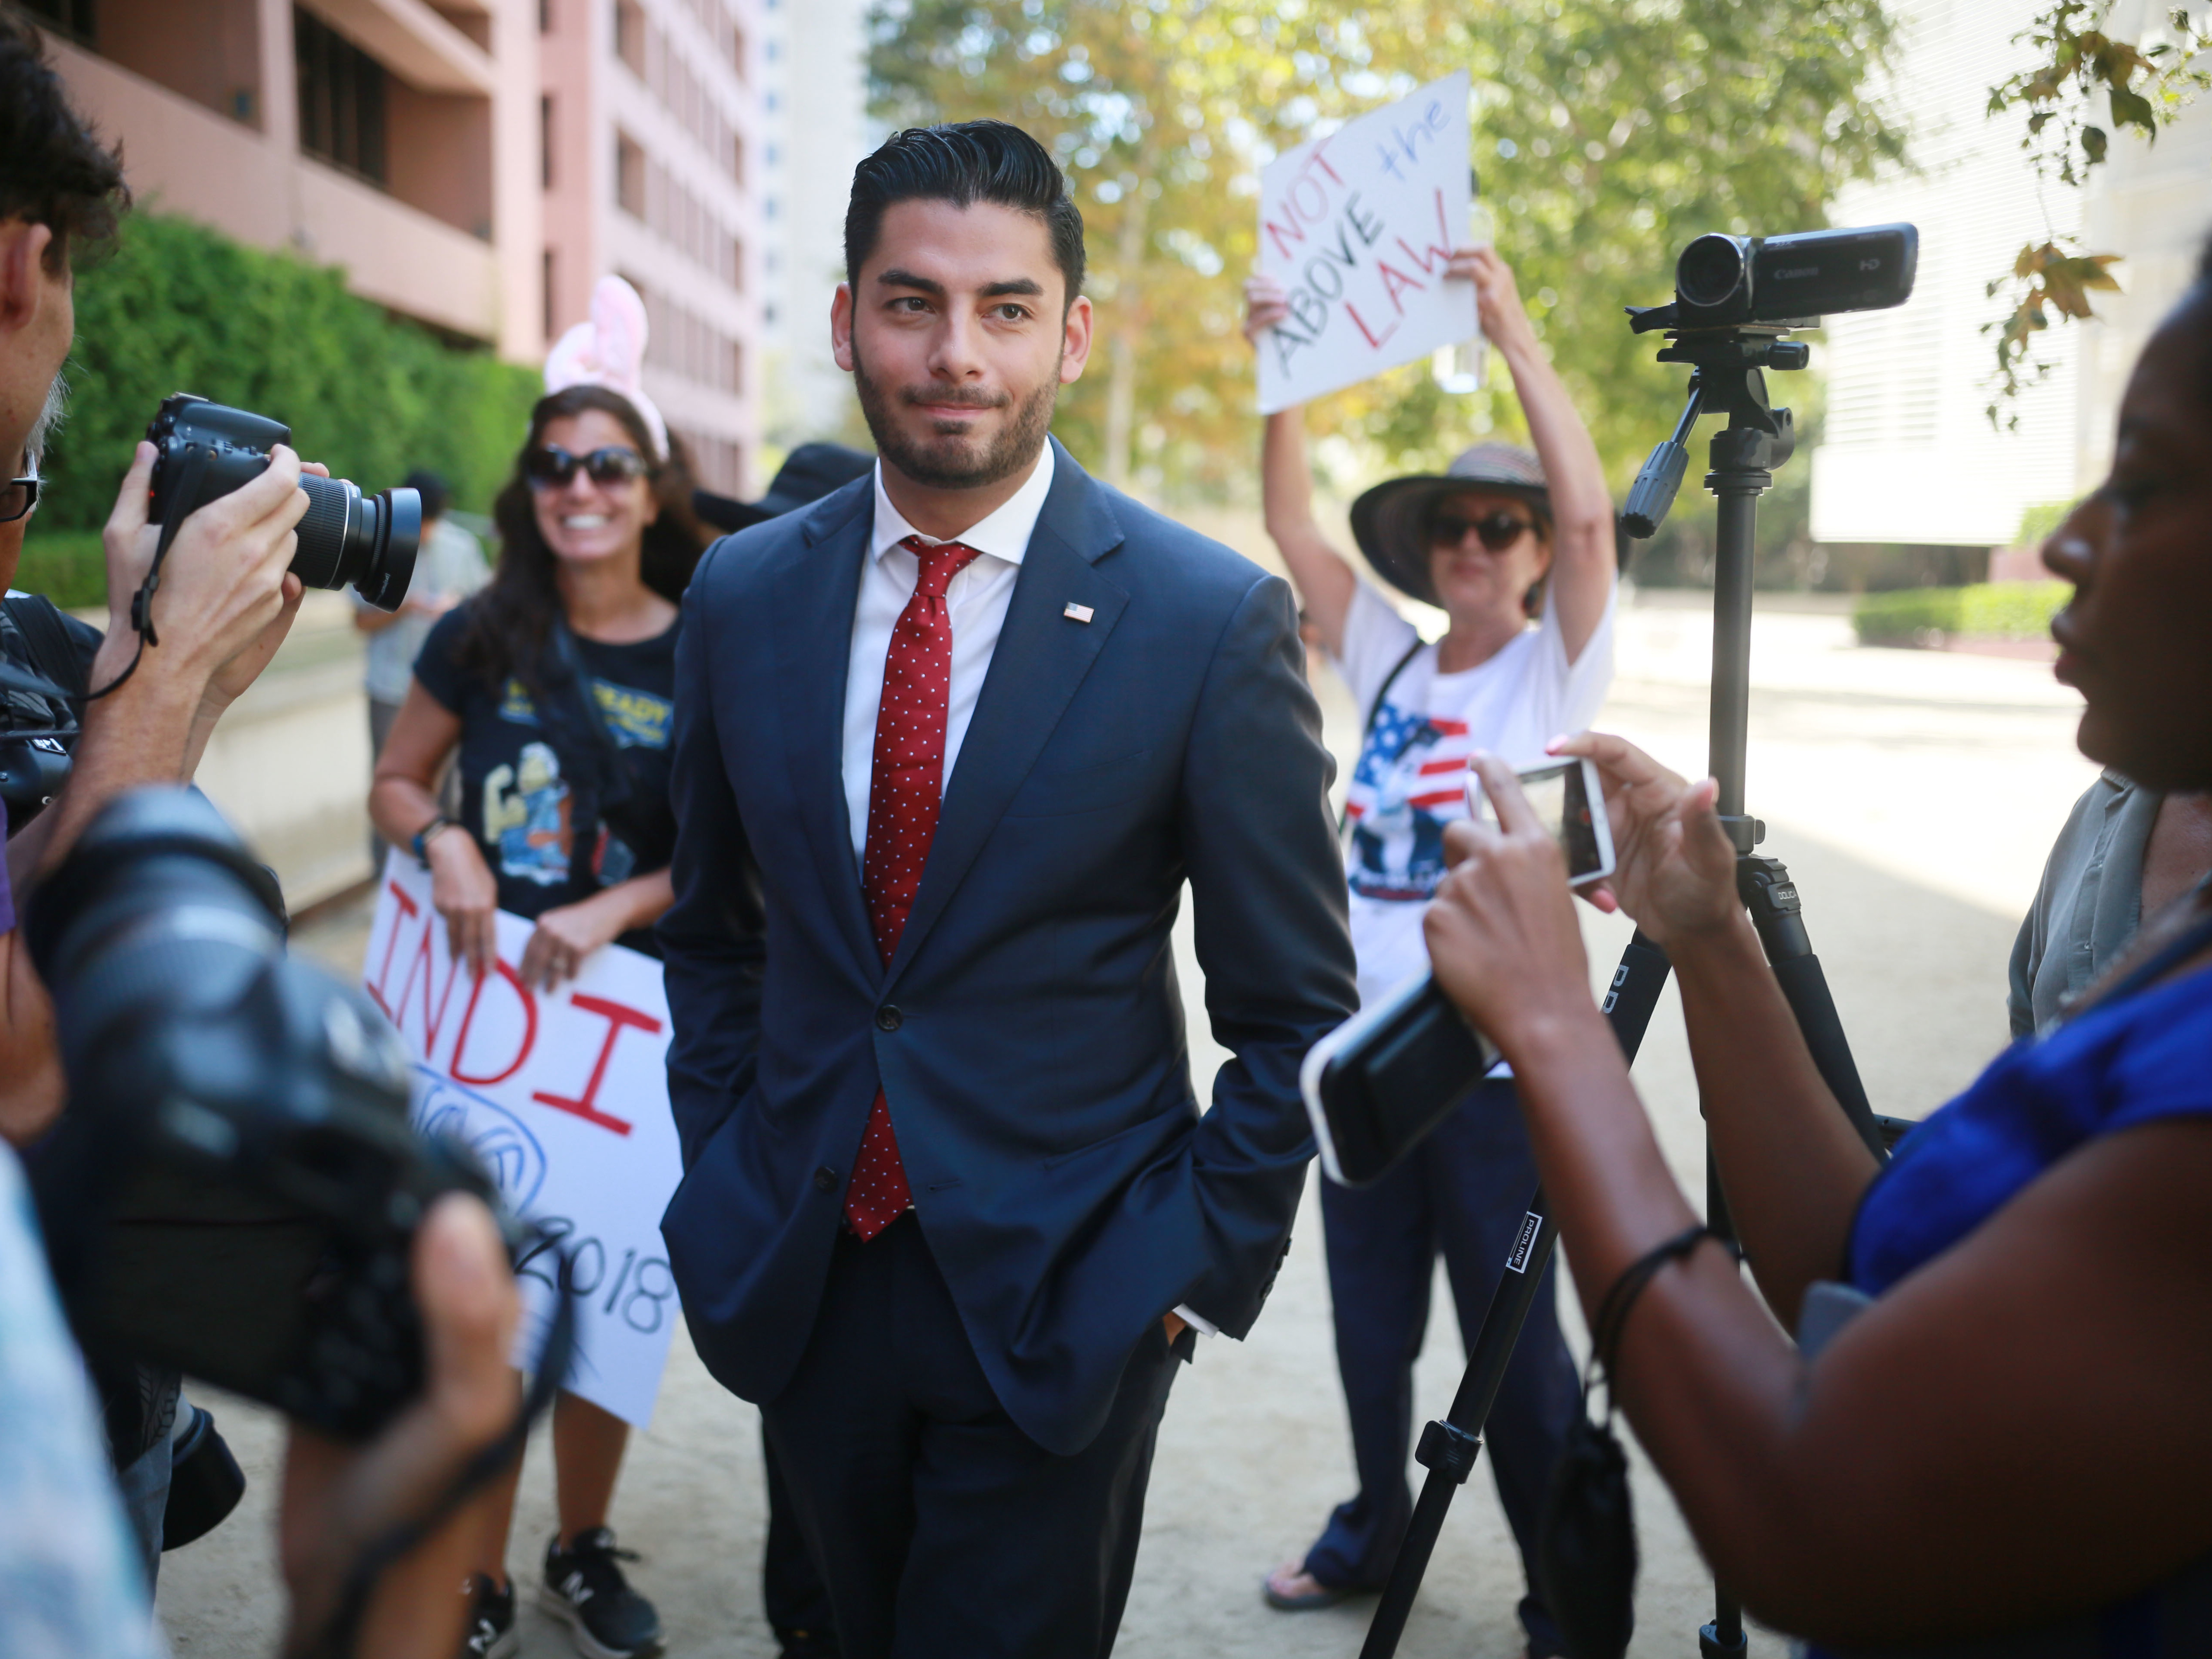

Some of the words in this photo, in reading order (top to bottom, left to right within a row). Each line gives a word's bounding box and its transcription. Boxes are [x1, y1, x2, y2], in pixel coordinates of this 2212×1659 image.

[1265, 137, 1343, 259] NOT
[1270, 189, 1385, 381] ABOVE
[1374, 99, 1451, 182] the
[1343, 188, 1451, 350] LAW
[514, 1216, 677, 1335] 2018
[1514, 1219, 1534, 1265] PROLINE
